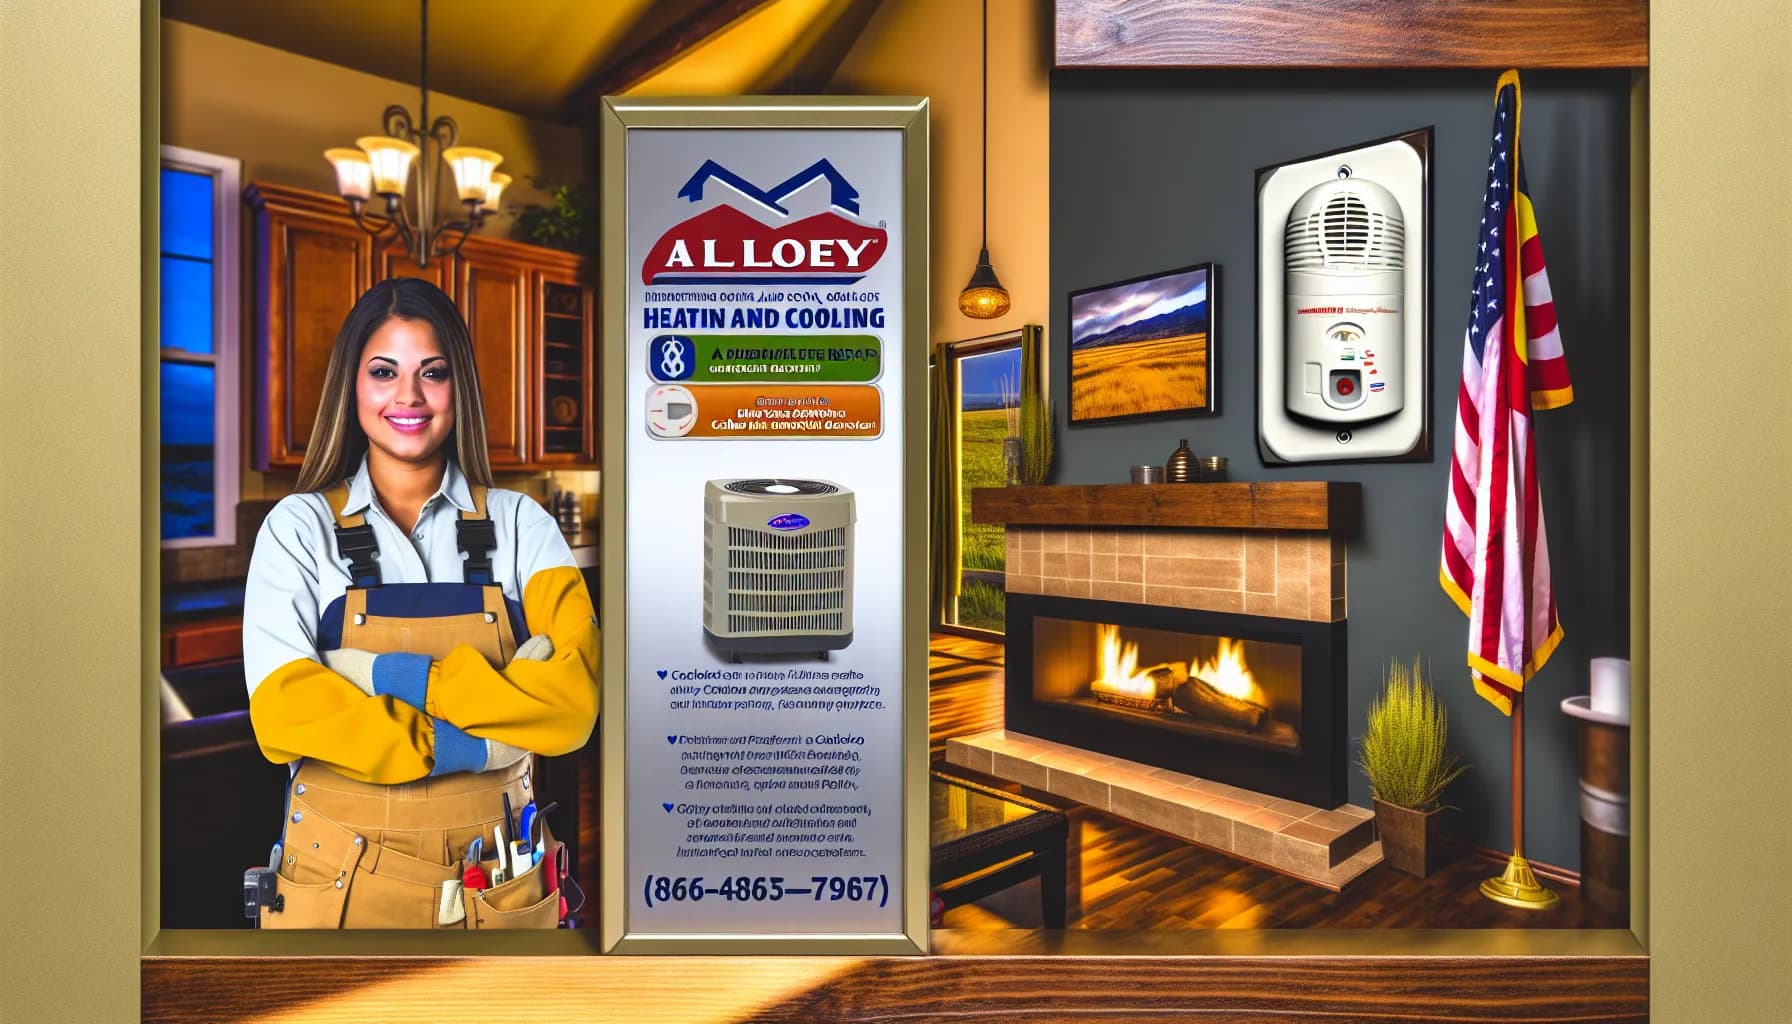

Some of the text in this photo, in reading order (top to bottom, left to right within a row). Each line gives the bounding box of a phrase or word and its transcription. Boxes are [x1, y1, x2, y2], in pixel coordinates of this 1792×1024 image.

[664, 239, 872, 268] ALLOEY
[643, 307, 885, 329] HEATIN AND COOLING
